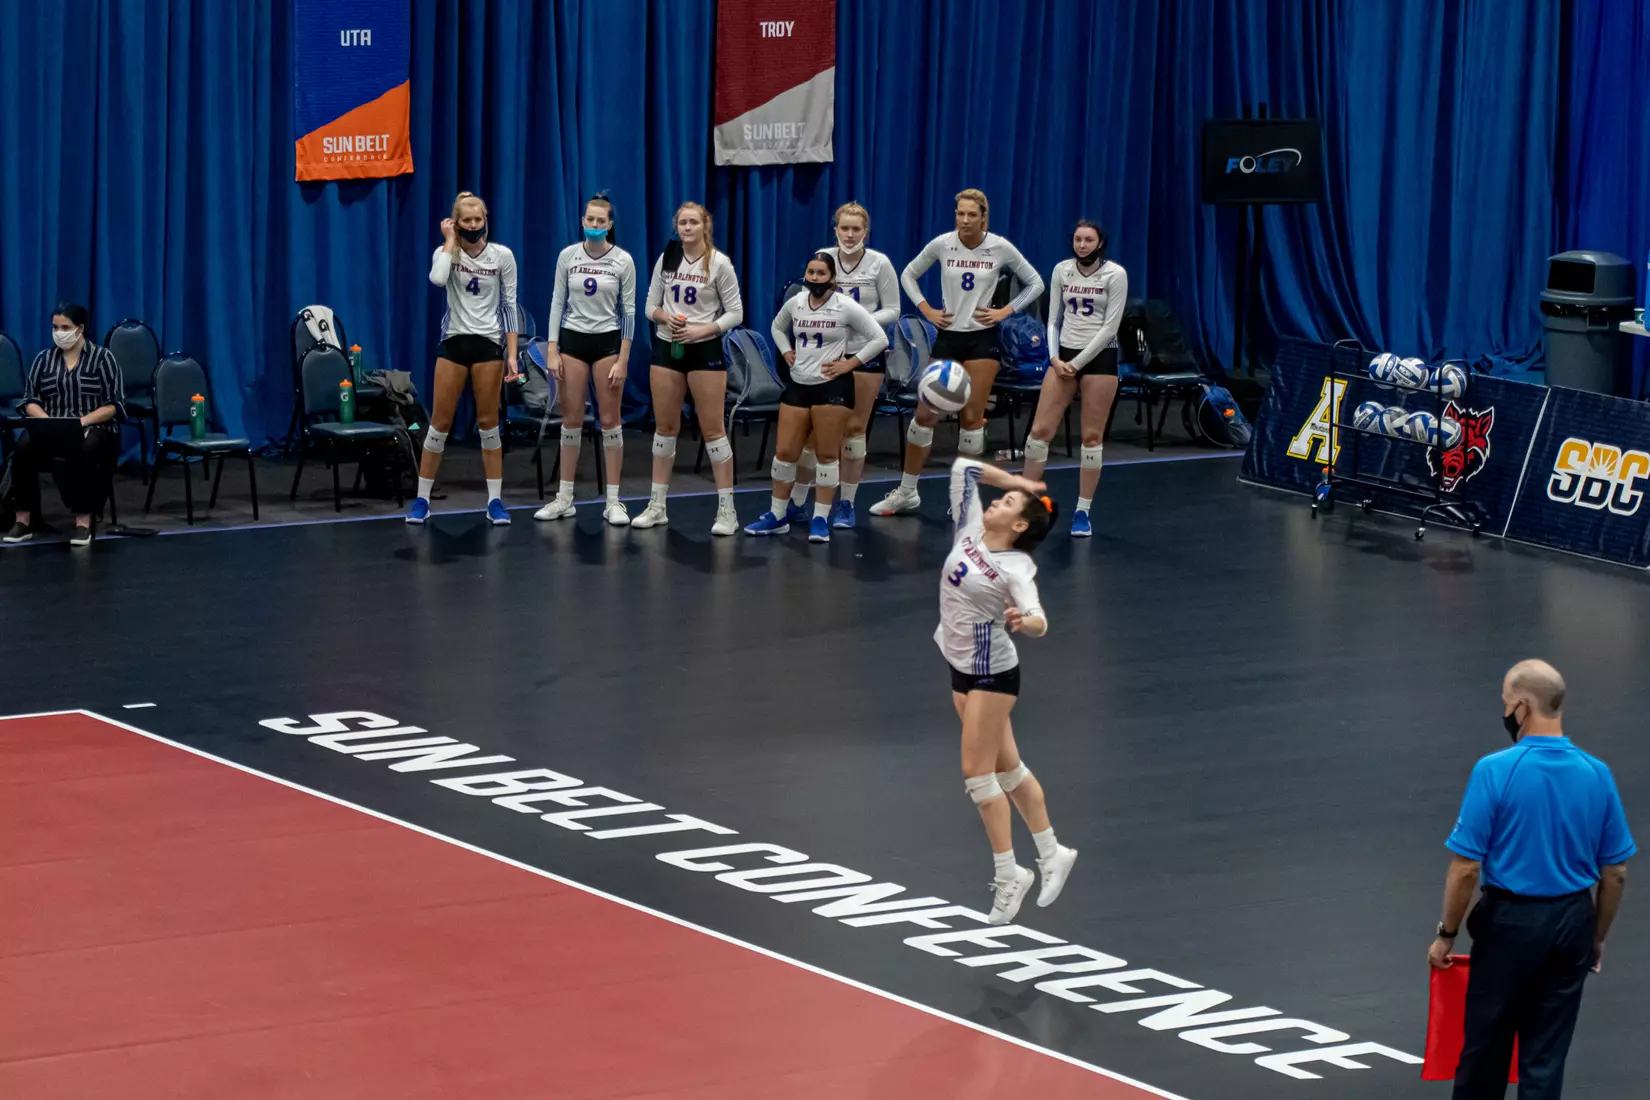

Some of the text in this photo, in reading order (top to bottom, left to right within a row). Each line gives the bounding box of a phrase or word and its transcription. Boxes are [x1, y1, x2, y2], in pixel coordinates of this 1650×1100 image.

[340, 29, 372, 46] UTA
[760, 21, 795, 38] TROY
[743, 122, 805, 140] SUN BELT
[323, 134, 390, 154] SUN BELT
[1225, 156, 1294, 174] FOLEY
[956, 260, 994, 269] ARLINGTON
[465, 277, 480, 295] 4
[583, 277, 598, 297] 9
[961, 272, 975, 291] 8
[671, 284, 697, 305] 18
[836, 286, 860, 303] 1
[1068, 297, 1094, 316] 15
[798, 320, 836, 328] ARLINGTON
[798, 332, 823, 348] 11
[340, 392, 349, 402] G
[1547, 437, 1650, 516] SBC
[948, 561, 968, 587] 3
[258, 711, 1425, 1080] SUN BELT CONFERENCE
